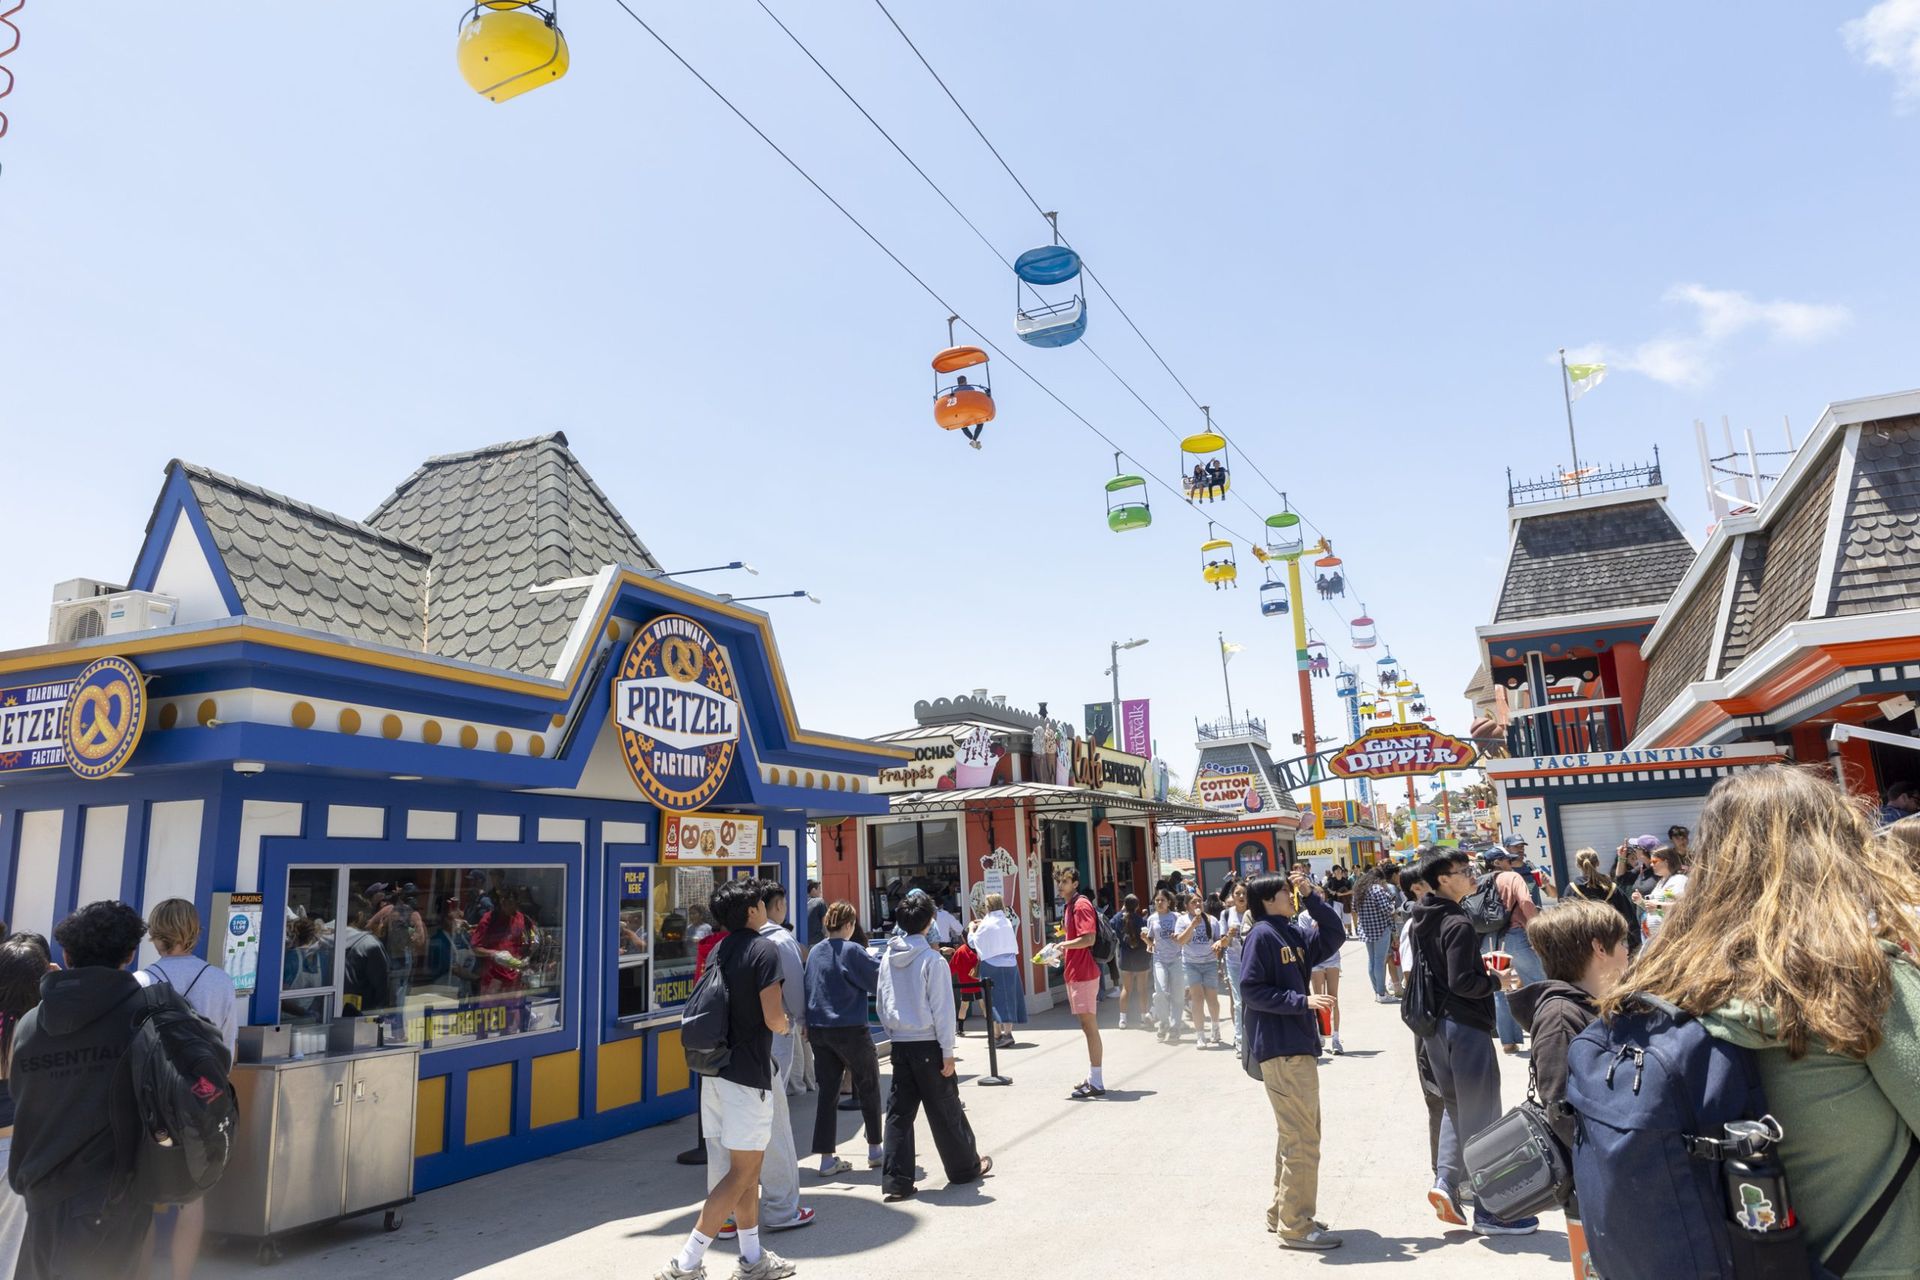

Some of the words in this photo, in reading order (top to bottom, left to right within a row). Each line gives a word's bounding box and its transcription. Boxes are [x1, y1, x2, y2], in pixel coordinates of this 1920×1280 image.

[946, 397, 958, 408] 23
[653, 618, 710, 651] BOARDWALK
[627, 686, 733, 736] PRETZEL
[1374, 726, 1399, 734] SANTA
[1364, 736, 1431, 752] GIANT
[653, 751, 706, 778] FACTORY
[1345, 747, 1458, 773] DIPPER
[1532, 754, 1590, 770] FACE
[1604, 745, 1724, 765] PAINTING
[1205, 762, 1249, 774] COASTER
[1200, 777, 1250, 791] COTTON
[1204, 789, 1246, 802] CANDY
[624, 872, 646, 882] PICK-UP
[628, 883, 642, 894] HERE
[231, 895, 263, 903] NAPKINS
[655, 979, 694, 1003] FRESHLY
[448, 1006, 507, 1035] CRAFTED
